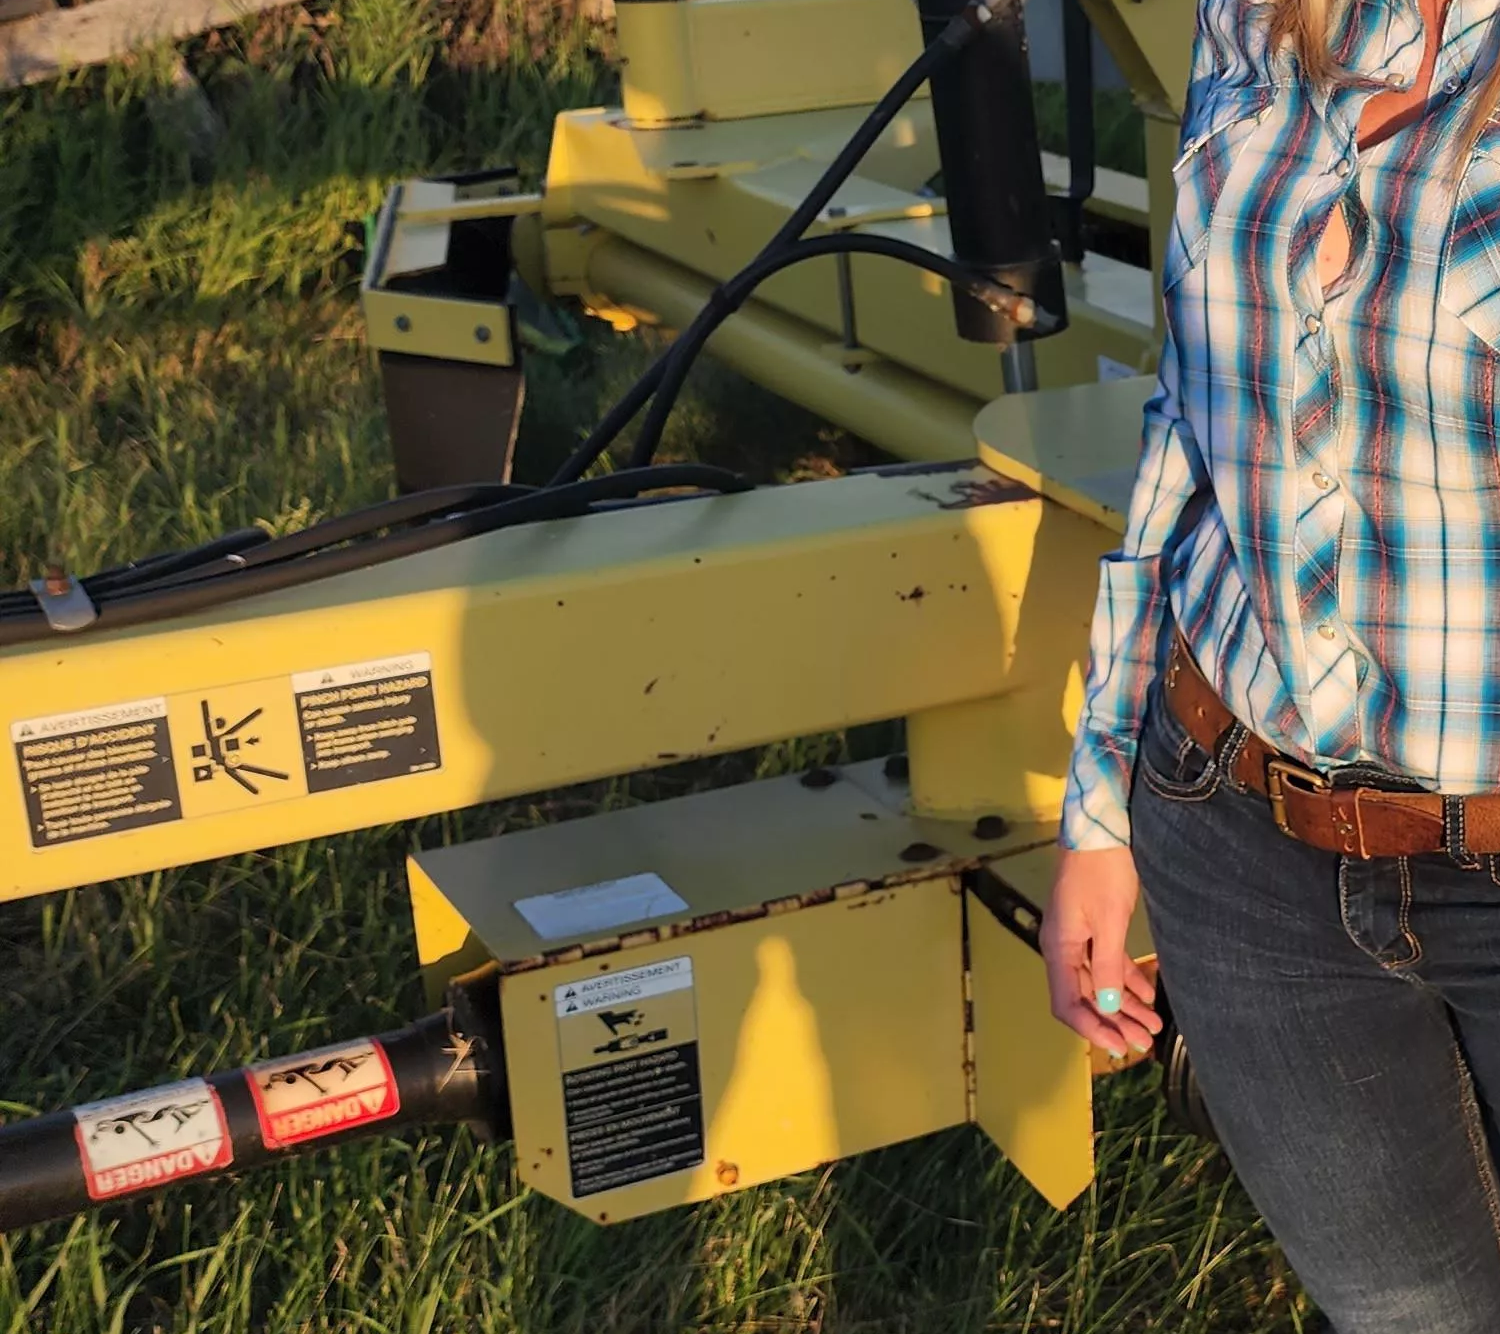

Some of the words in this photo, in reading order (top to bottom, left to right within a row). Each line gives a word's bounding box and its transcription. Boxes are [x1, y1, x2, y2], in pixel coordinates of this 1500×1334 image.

[349, 659, 414, 677] WARNING
[38, 703, 161, 733] AVERTISSEMENT
[582, 962, 680, 993] AVERTISSEMENT
[583, 986, 642, 1007] WARNING
[270, 1097, 361, 1140] DANGER
[96, 1149, 194, 1193] DANGER
